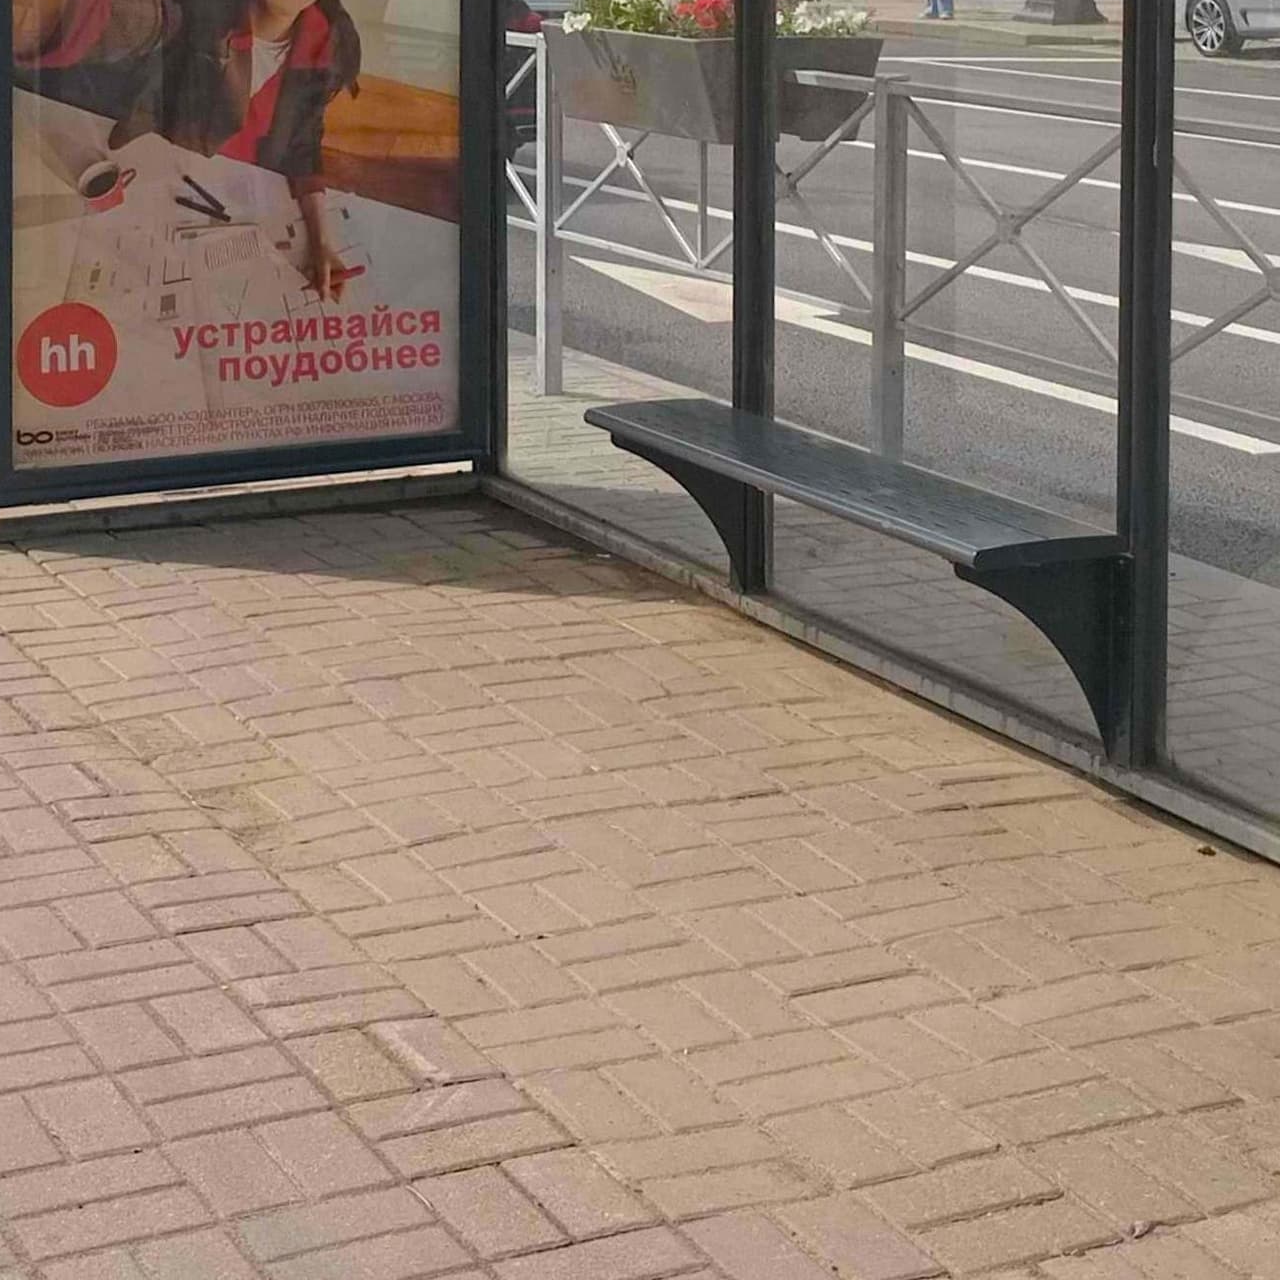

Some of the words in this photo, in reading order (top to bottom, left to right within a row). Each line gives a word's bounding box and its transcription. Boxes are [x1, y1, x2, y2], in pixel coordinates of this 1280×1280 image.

[40, 334, 96, 374] hh
[173, 304, 441, 360] устраивайся
[219, 339, 441, 387] поудобнее
